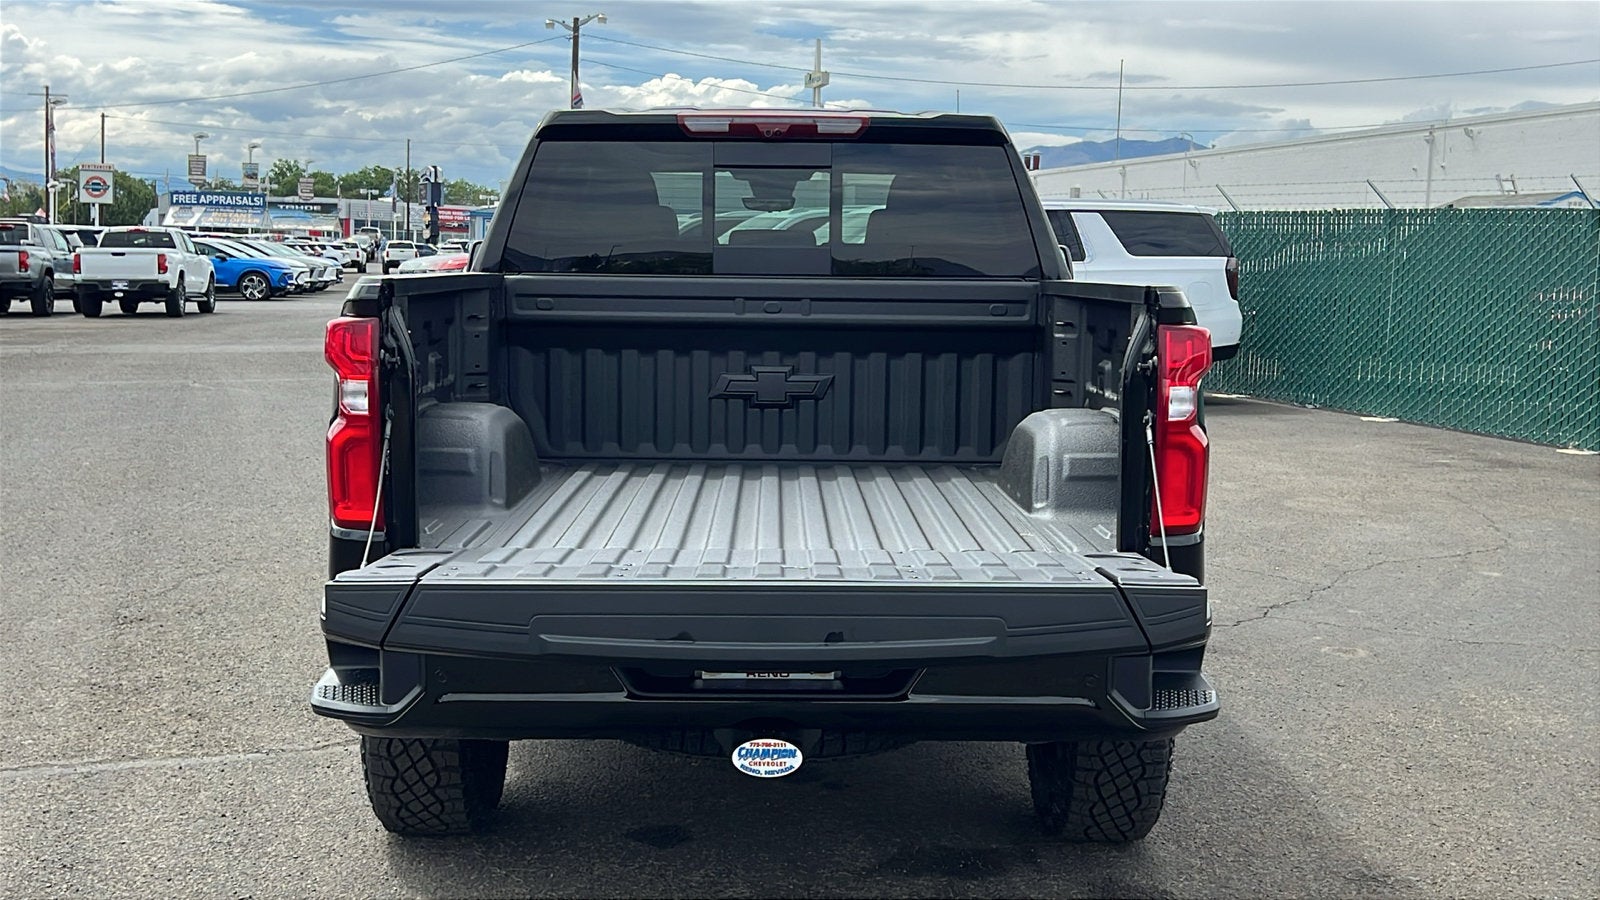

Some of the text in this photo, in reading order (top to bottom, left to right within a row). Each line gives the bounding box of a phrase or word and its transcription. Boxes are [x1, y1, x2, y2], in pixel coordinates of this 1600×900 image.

[172, 194, 264, 206] FREE APPRAISALS!
[738, 746, 798, 760] CHAMPION
[740, 764, 795, 775] RENO, NEVADA
